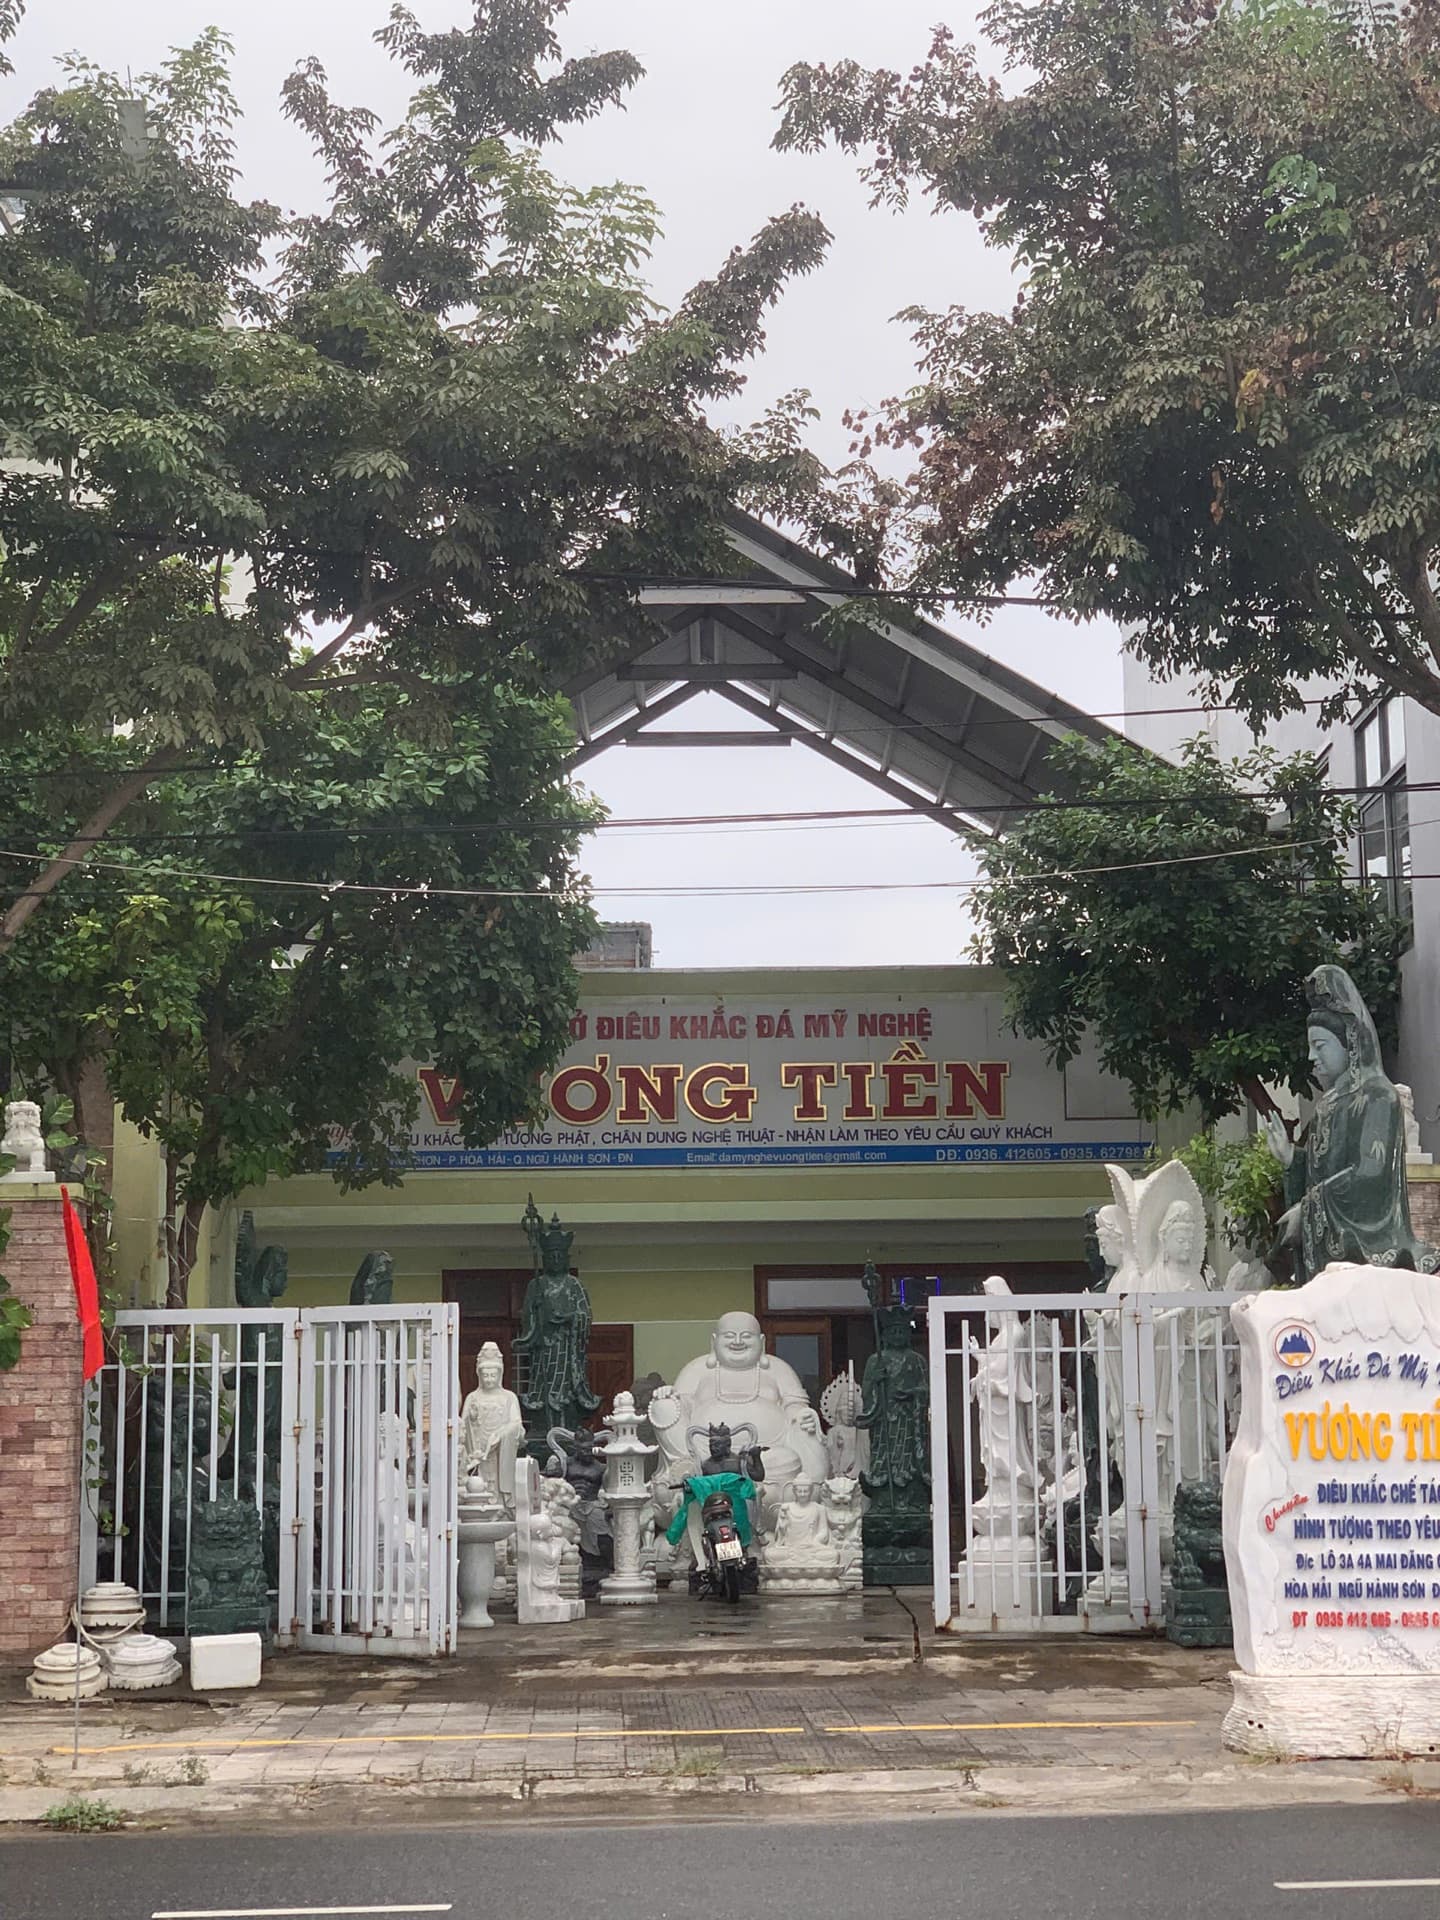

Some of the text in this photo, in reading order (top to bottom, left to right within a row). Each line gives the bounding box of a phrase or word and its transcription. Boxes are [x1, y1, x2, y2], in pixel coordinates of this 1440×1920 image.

[596, 1011, 660, 1040] ĐIÊU
[669, 1005, 747, 1040] KHẮC
[756, 1009, 794, 1039] ĐÁ
[804, 1009, 848, 1039] MỸ
[858, 1007, 933, 1042] NGHỆ
[417, 1039, 1010, 1127] VƠNG TIỀN
[601, 1129, 642, 1145] CHÂN
[647, 1130, 687, 1144] DUNG
[692, 1128, 731, 1146] NGHỆ
[736, 1127, 775, 1145] THUẬT
[830, 1125, 859, 1141] LÀM
[864, 1128, 899, 1141] THEO
[904, 1125, 931, 1141] YÊU
[1006, 1122, 1053, 1139] KHÁCH
[1318, 1352, 1361, 1384] Khắc
[1366, 1351, 1392, 1378] Đá
[1398, 1353, 1429, 1389] Mỹ
[1284, 1400, 1394, 1462] VƯƠNG
[1317, 1478, 1348, 1505] ĐIÊU
[1351, 1473, 1388, 1505] KHẮC
[1390, 1475, 1417, 1505] CHẾ
[1294, 1513, 1326, 1540] HÌNH
[1329, 1515, 1374, 1545] TƯỢNG
[1377, 1518, 1412, 1540] THEO
[1321, 1549, 1336, 1570] LÔ
[1339, 1553, 1354, 1570] 3A
[1357, 1553, 1373, 1570] 4A
[1375, 1553, 1397, 1570] MAI
[1284, 1578, 1309, 1599] HÒA
[1312, 1576, 1332, 1599] HẢI
[1338, 1578, 1363, 1599] NGŨ
[1366, 1578, 1400, 1599] HÀNH
[1403, 1579, 1426, 1599] SƠN
